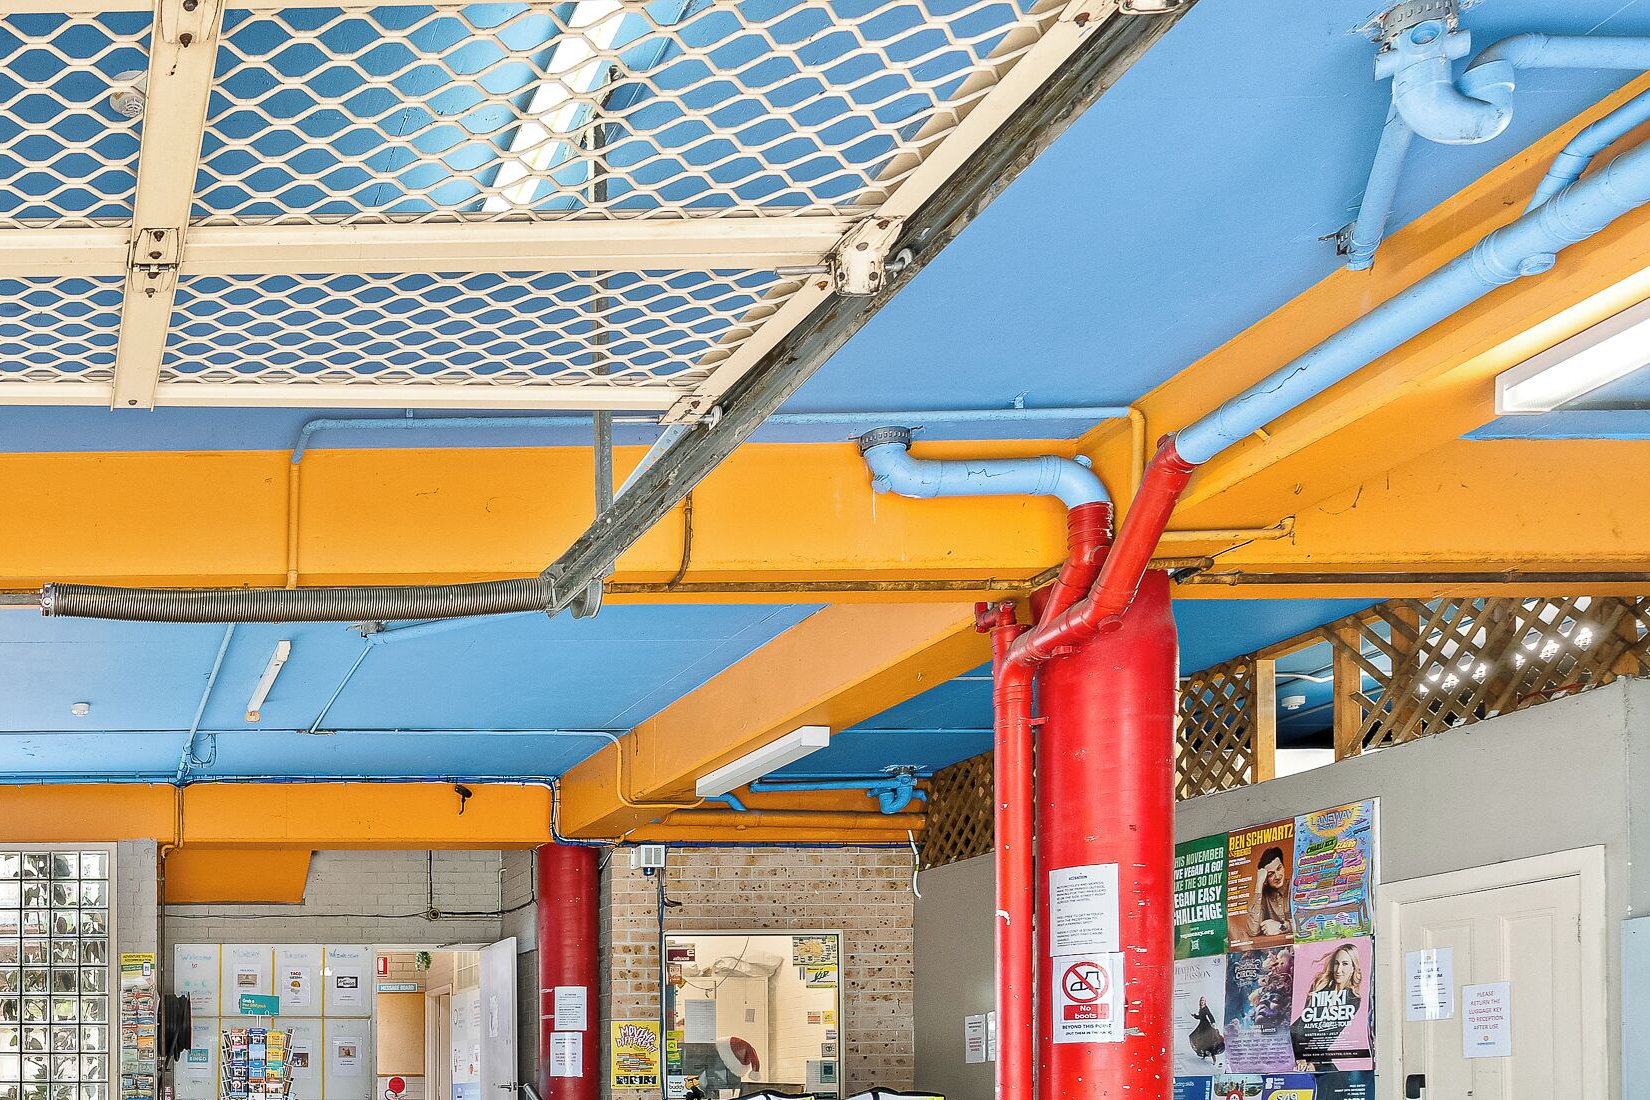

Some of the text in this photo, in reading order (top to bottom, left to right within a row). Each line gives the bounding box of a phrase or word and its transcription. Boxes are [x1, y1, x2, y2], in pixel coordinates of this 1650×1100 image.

[1229, 834, 1245, 851] BEN
[1246, 823, 1294, 848] SCHWARTZ
[1186, 847, 1224, 865] NOVEMBER
[1184, 865, 1204, 879] VEGAN
[1204, 862, 1210, 873] A
[1211, 860, 1223, 872] GO!
[1185, 878, 1196, 890] THE
[1197, 875, 1207, 888] 30
[1208, 872, 1223, 885] DAY
[1198, 885, 1223, 904] EASY
[1311, 989, 1347, 1007] NIKKI
[1301, 1004, 1355, 1022] GLASER
[1468, 1007, 1492, 1015] LUGGAGE
[619, 1024, 657, 1042] MOVING
[615, 1036, 658, 1054] DIFFERENT
